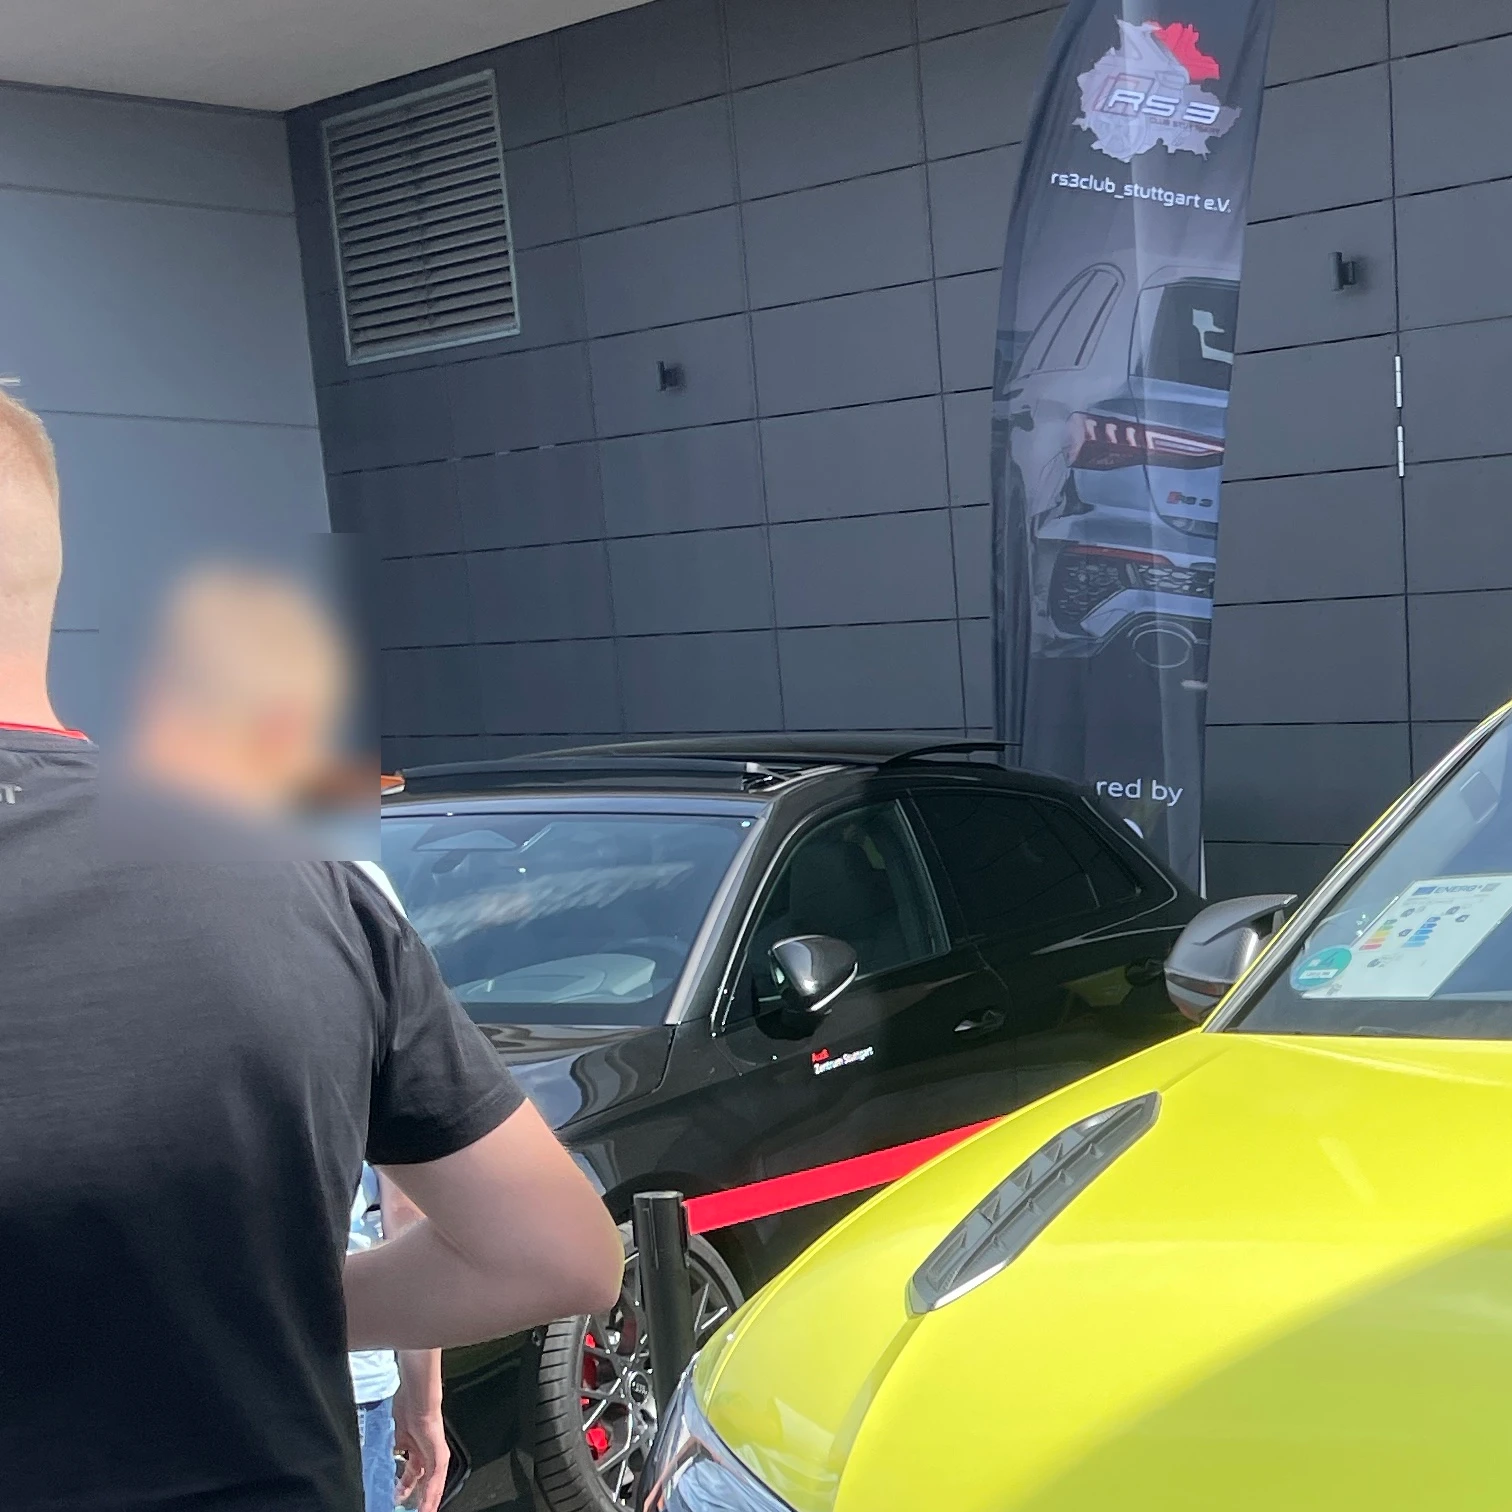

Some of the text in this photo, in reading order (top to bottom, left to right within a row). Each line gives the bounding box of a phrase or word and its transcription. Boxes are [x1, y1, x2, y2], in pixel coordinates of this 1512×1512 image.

[1107, 88, 1221, 125] RS 3
[1050, 171, 1201, 208] rs3club_stuttgart
[1151, 779, 1184, 807] by
